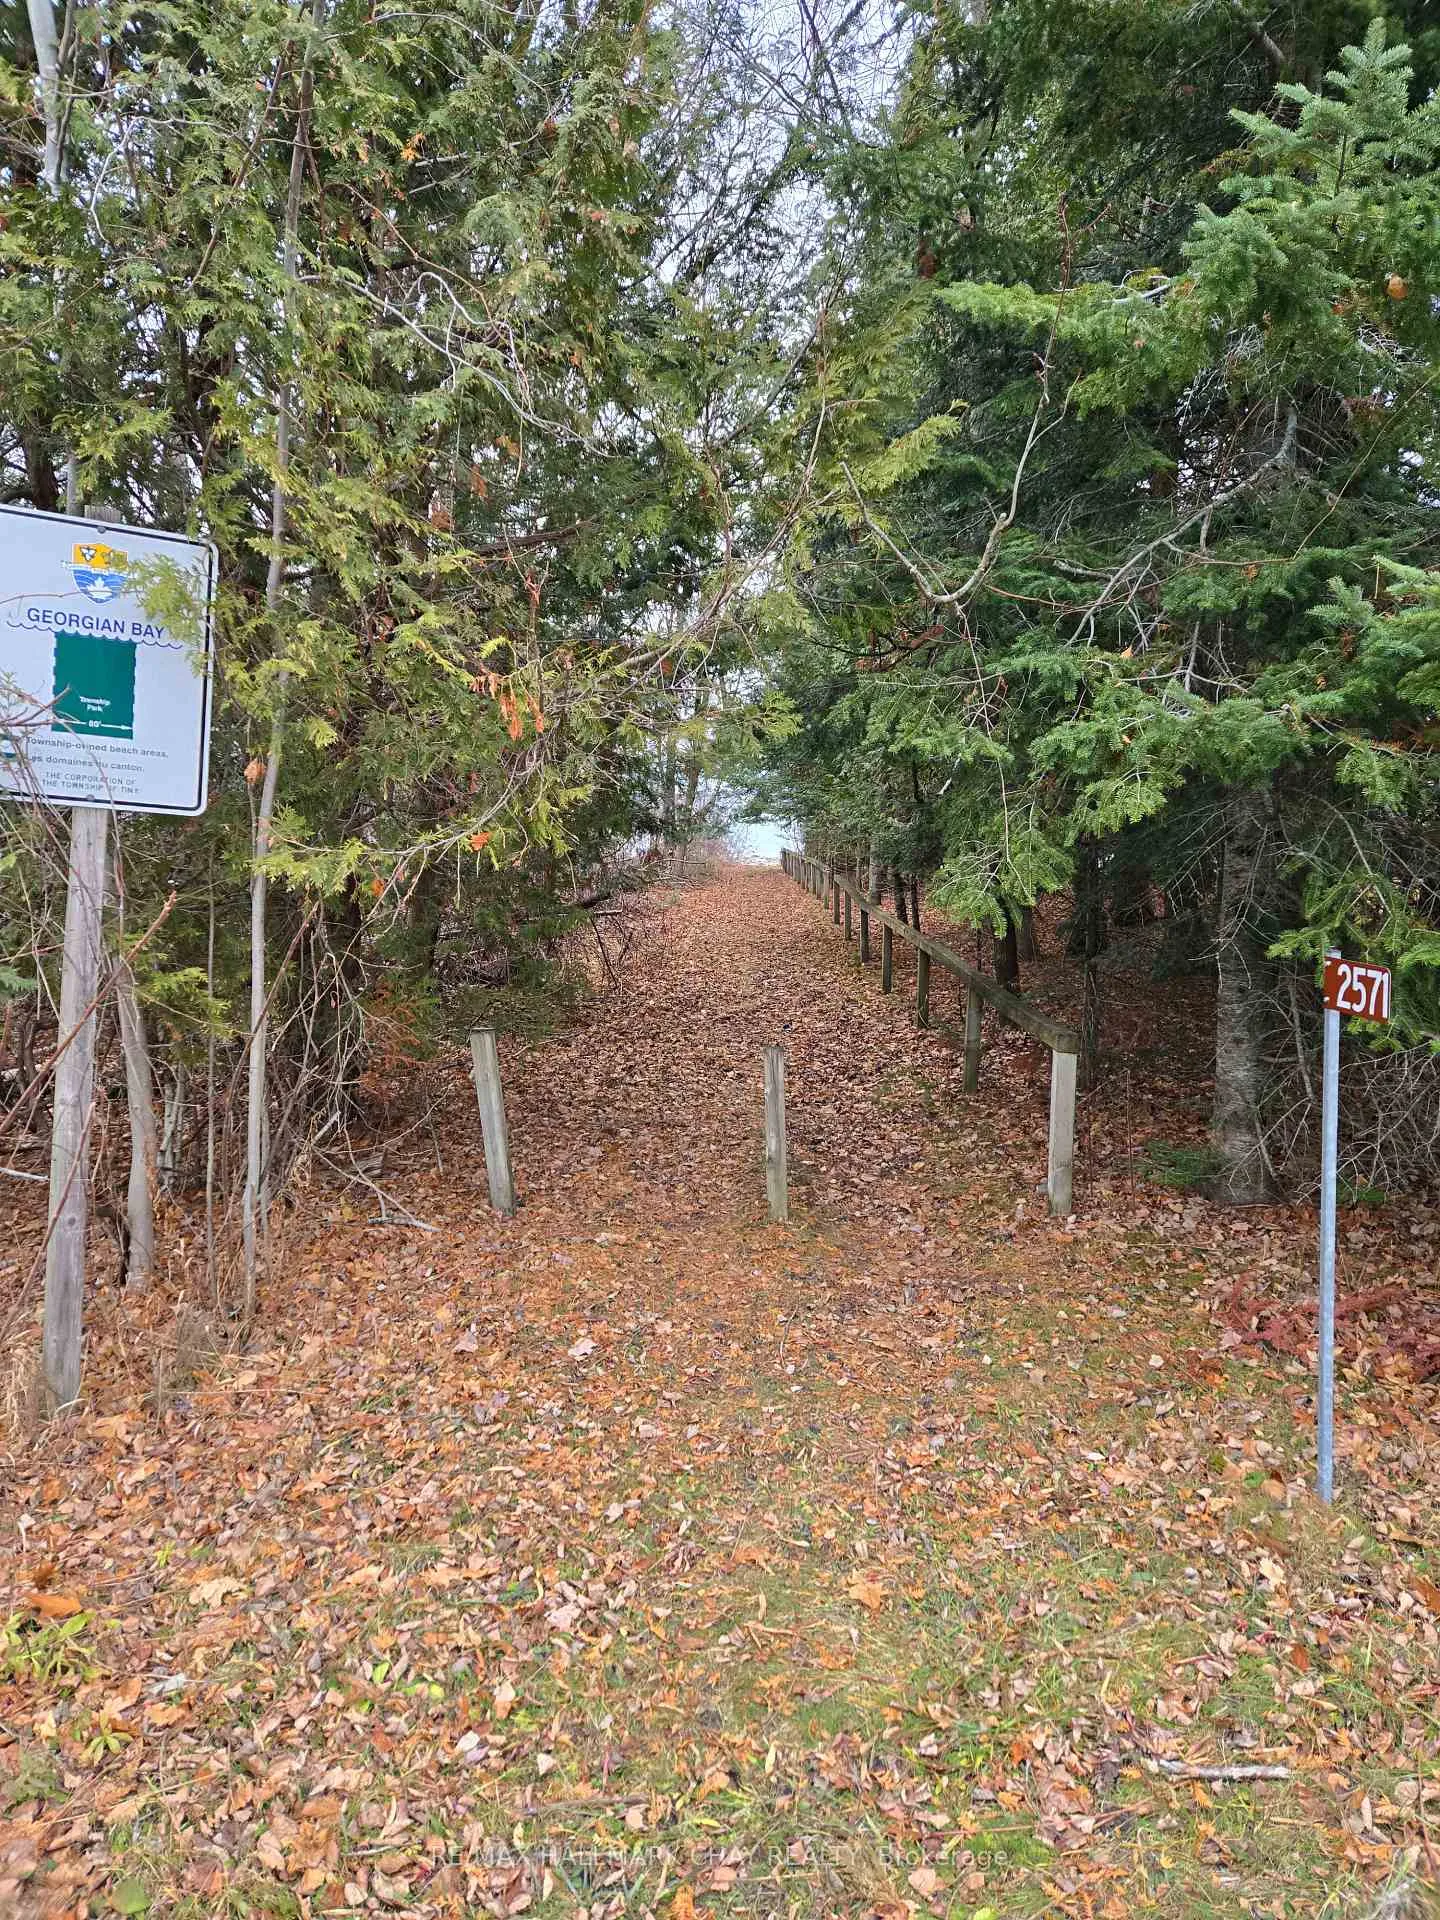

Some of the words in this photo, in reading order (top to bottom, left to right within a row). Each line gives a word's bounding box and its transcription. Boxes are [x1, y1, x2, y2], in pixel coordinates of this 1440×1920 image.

[27, 607, 125, 633] GEORGIAN
[132, 622, 164, 639] BAY
[109, 744, 138, 755] beach
[64, 773, 123, 785] CORPORION
[1336, 963, 1389, 1018] 2571
